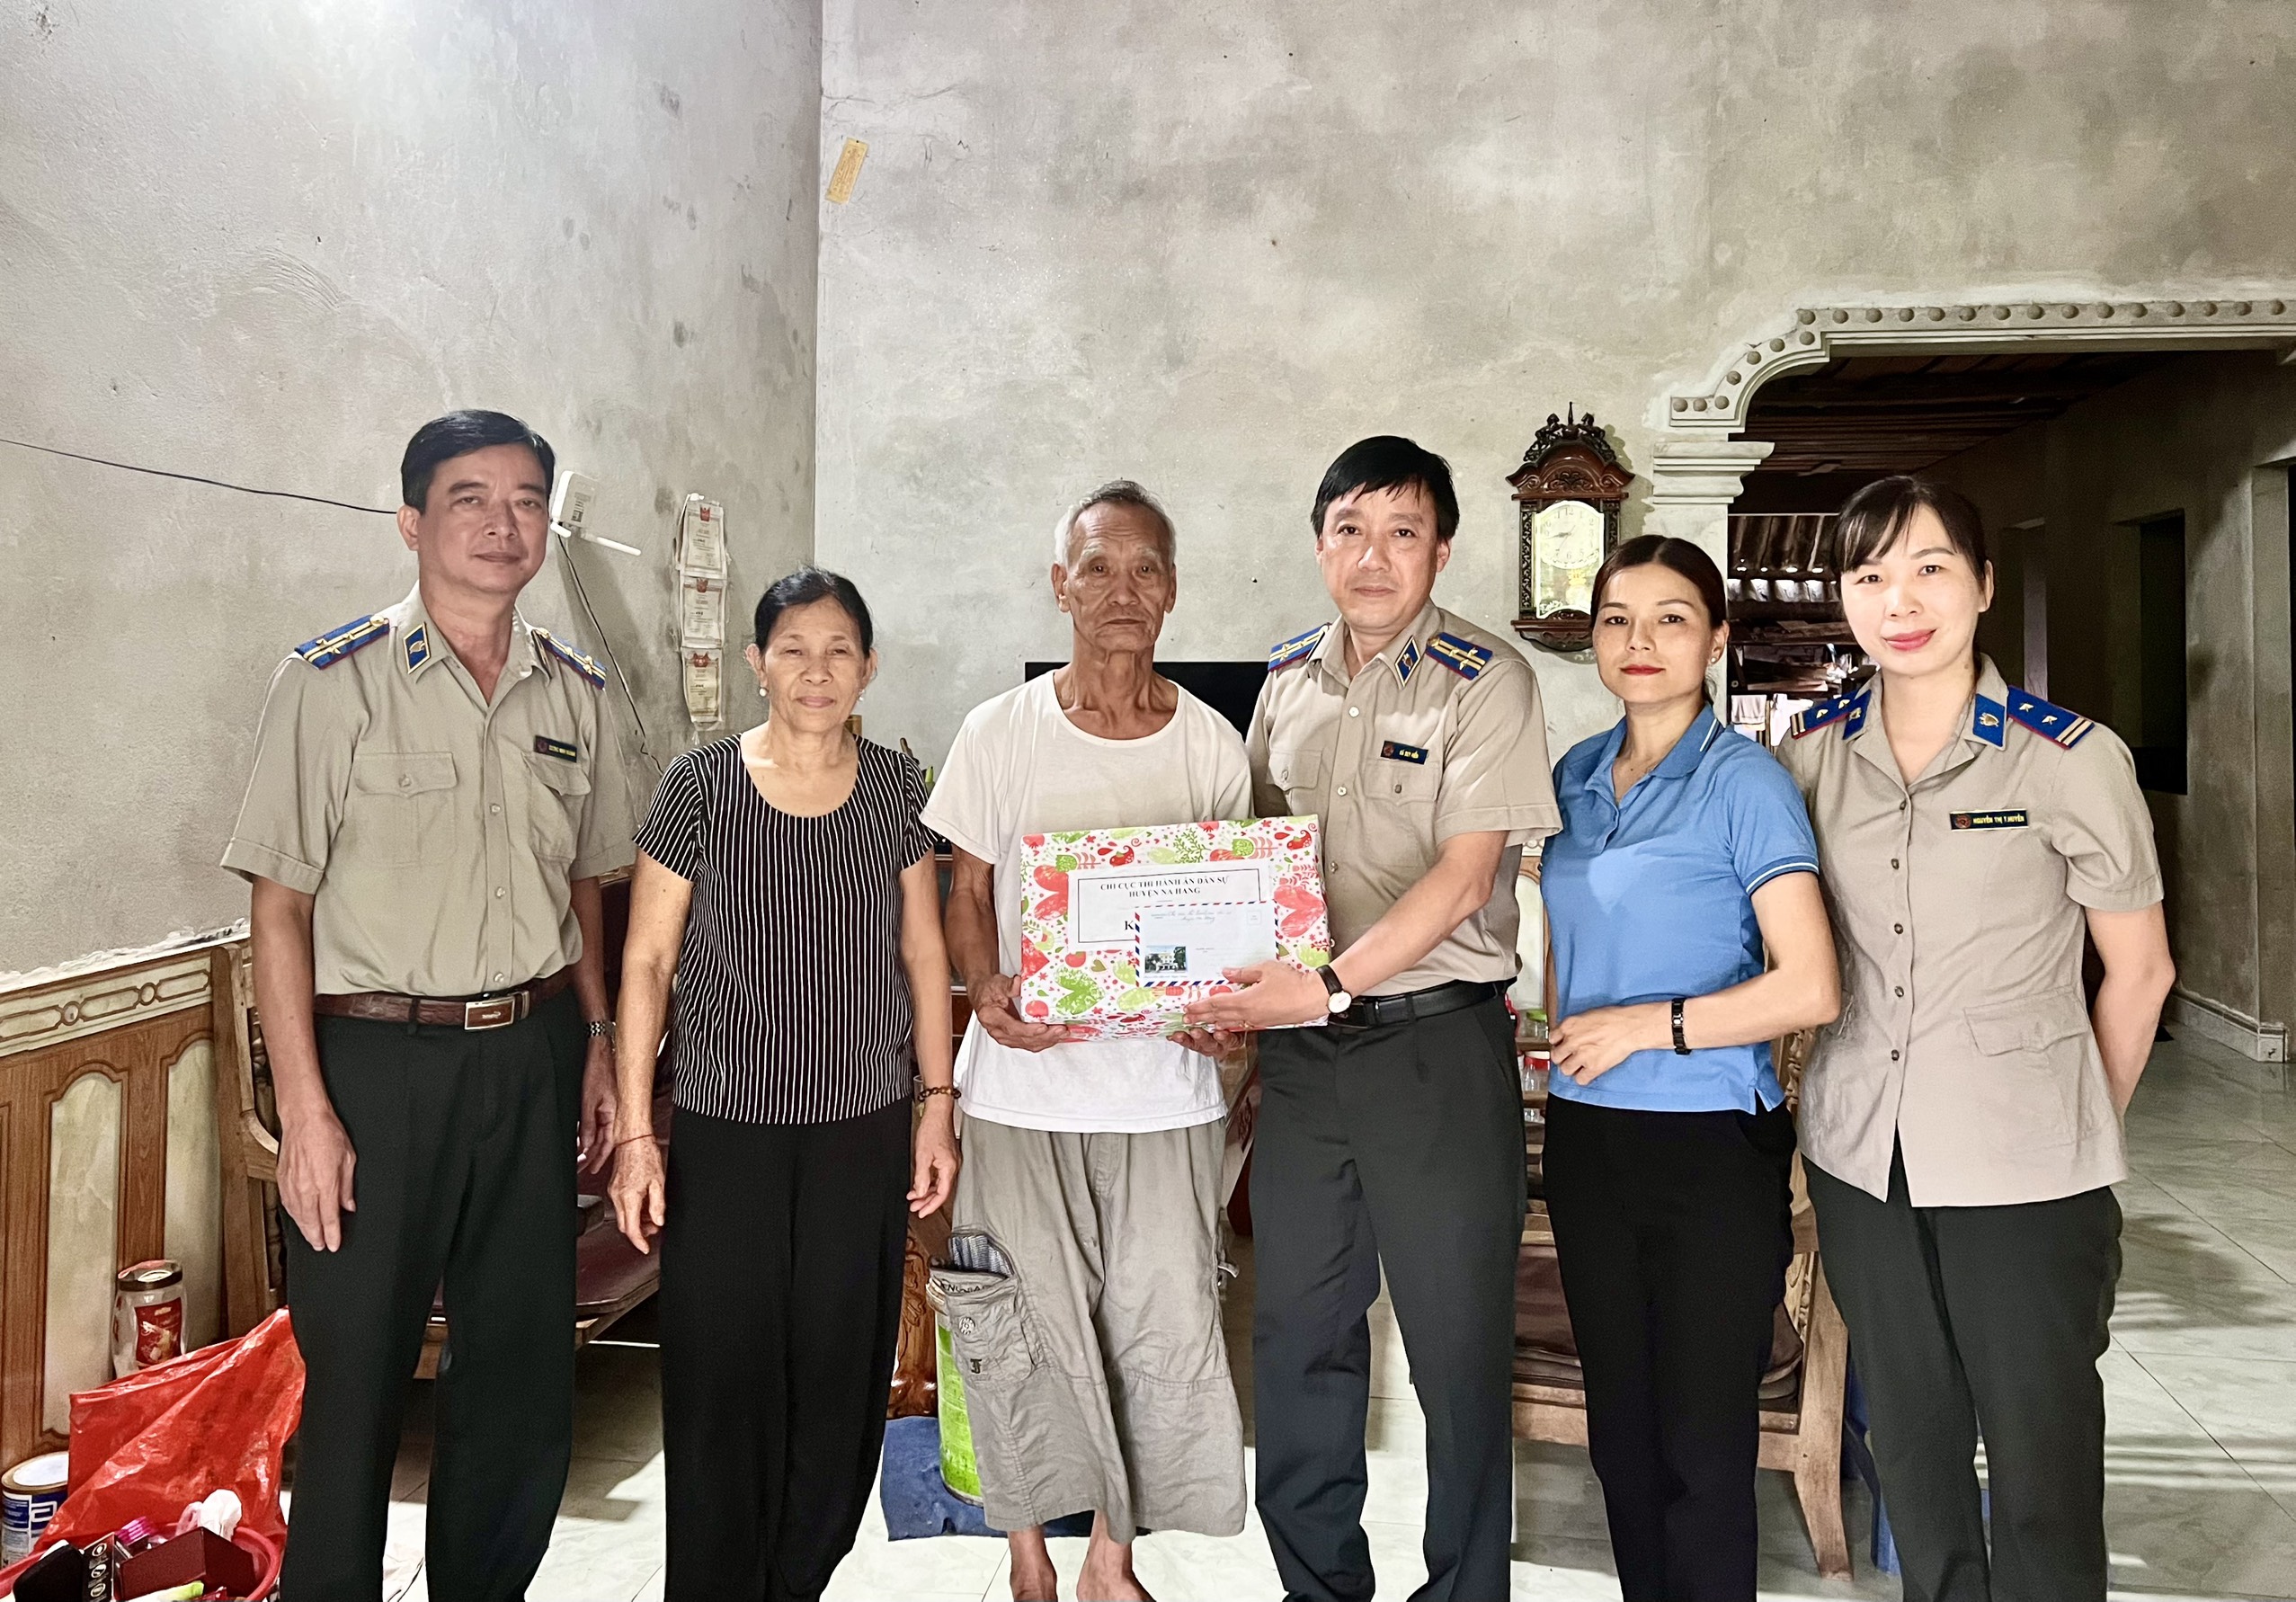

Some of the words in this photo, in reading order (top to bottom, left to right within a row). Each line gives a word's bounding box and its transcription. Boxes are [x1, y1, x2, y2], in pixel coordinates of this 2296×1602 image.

[1100, 883, 1116, 891] CHI
[1117, 882, 1137, 890] CỤC
[1138, 880, 1153, 888] THI
[1129, 889, 1159, 898] HUYỆN
[1175, 886, 1201, 895] HANG
